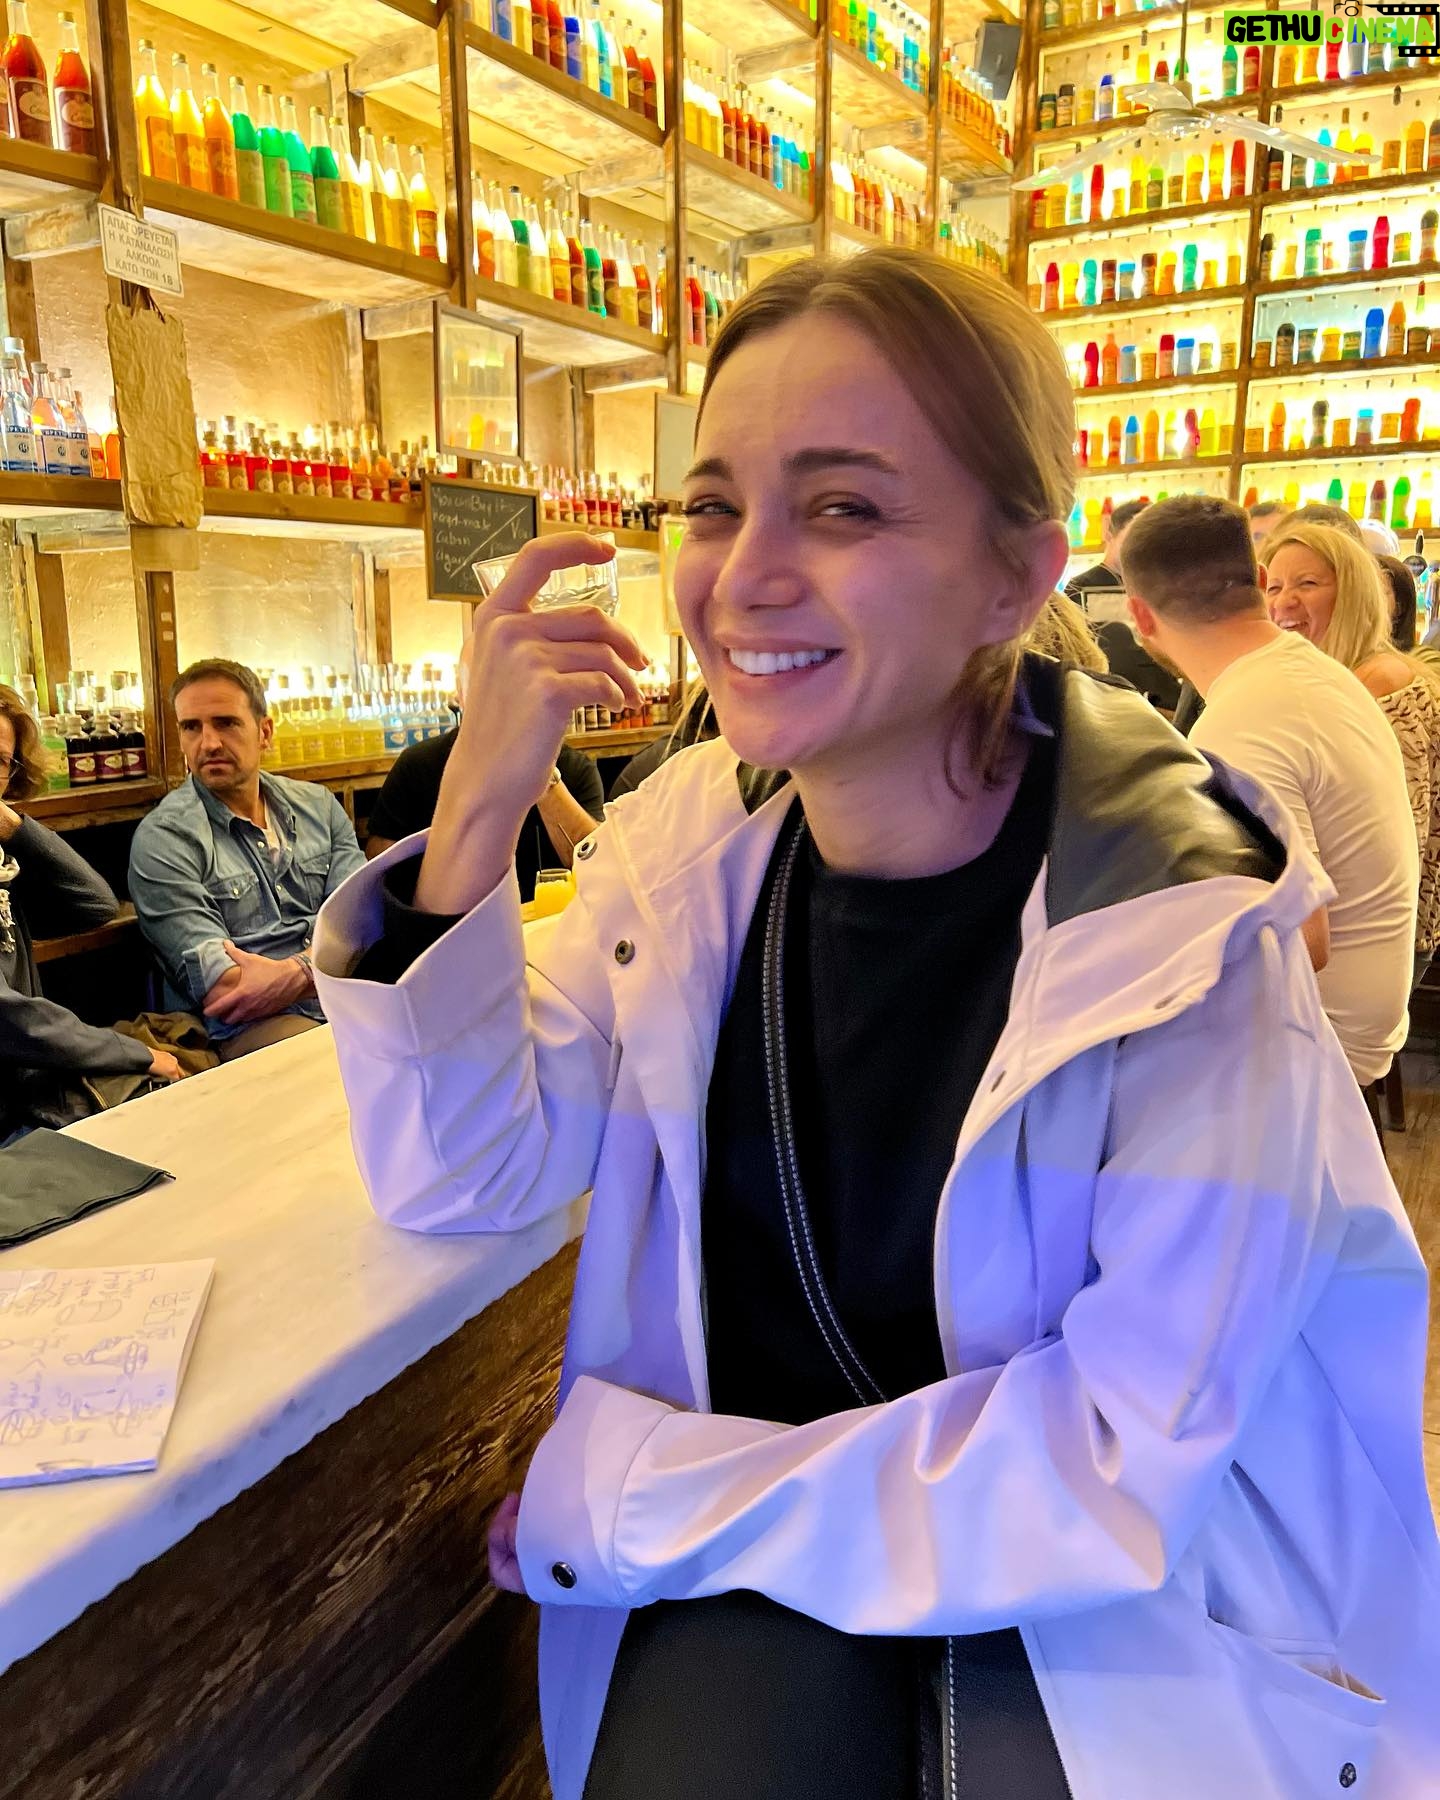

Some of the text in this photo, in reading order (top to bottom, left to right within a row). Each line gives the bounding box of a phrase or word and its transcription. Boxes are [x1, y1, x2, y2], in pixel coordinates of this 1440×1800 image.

[107, 216, 173, 248] ΑΠΑΓΟΡΕΥΕΤΑΙ
[126, 249, 161, 269] ΑΛΚΟΟΛ
[162, 273, 174, 286] 18
